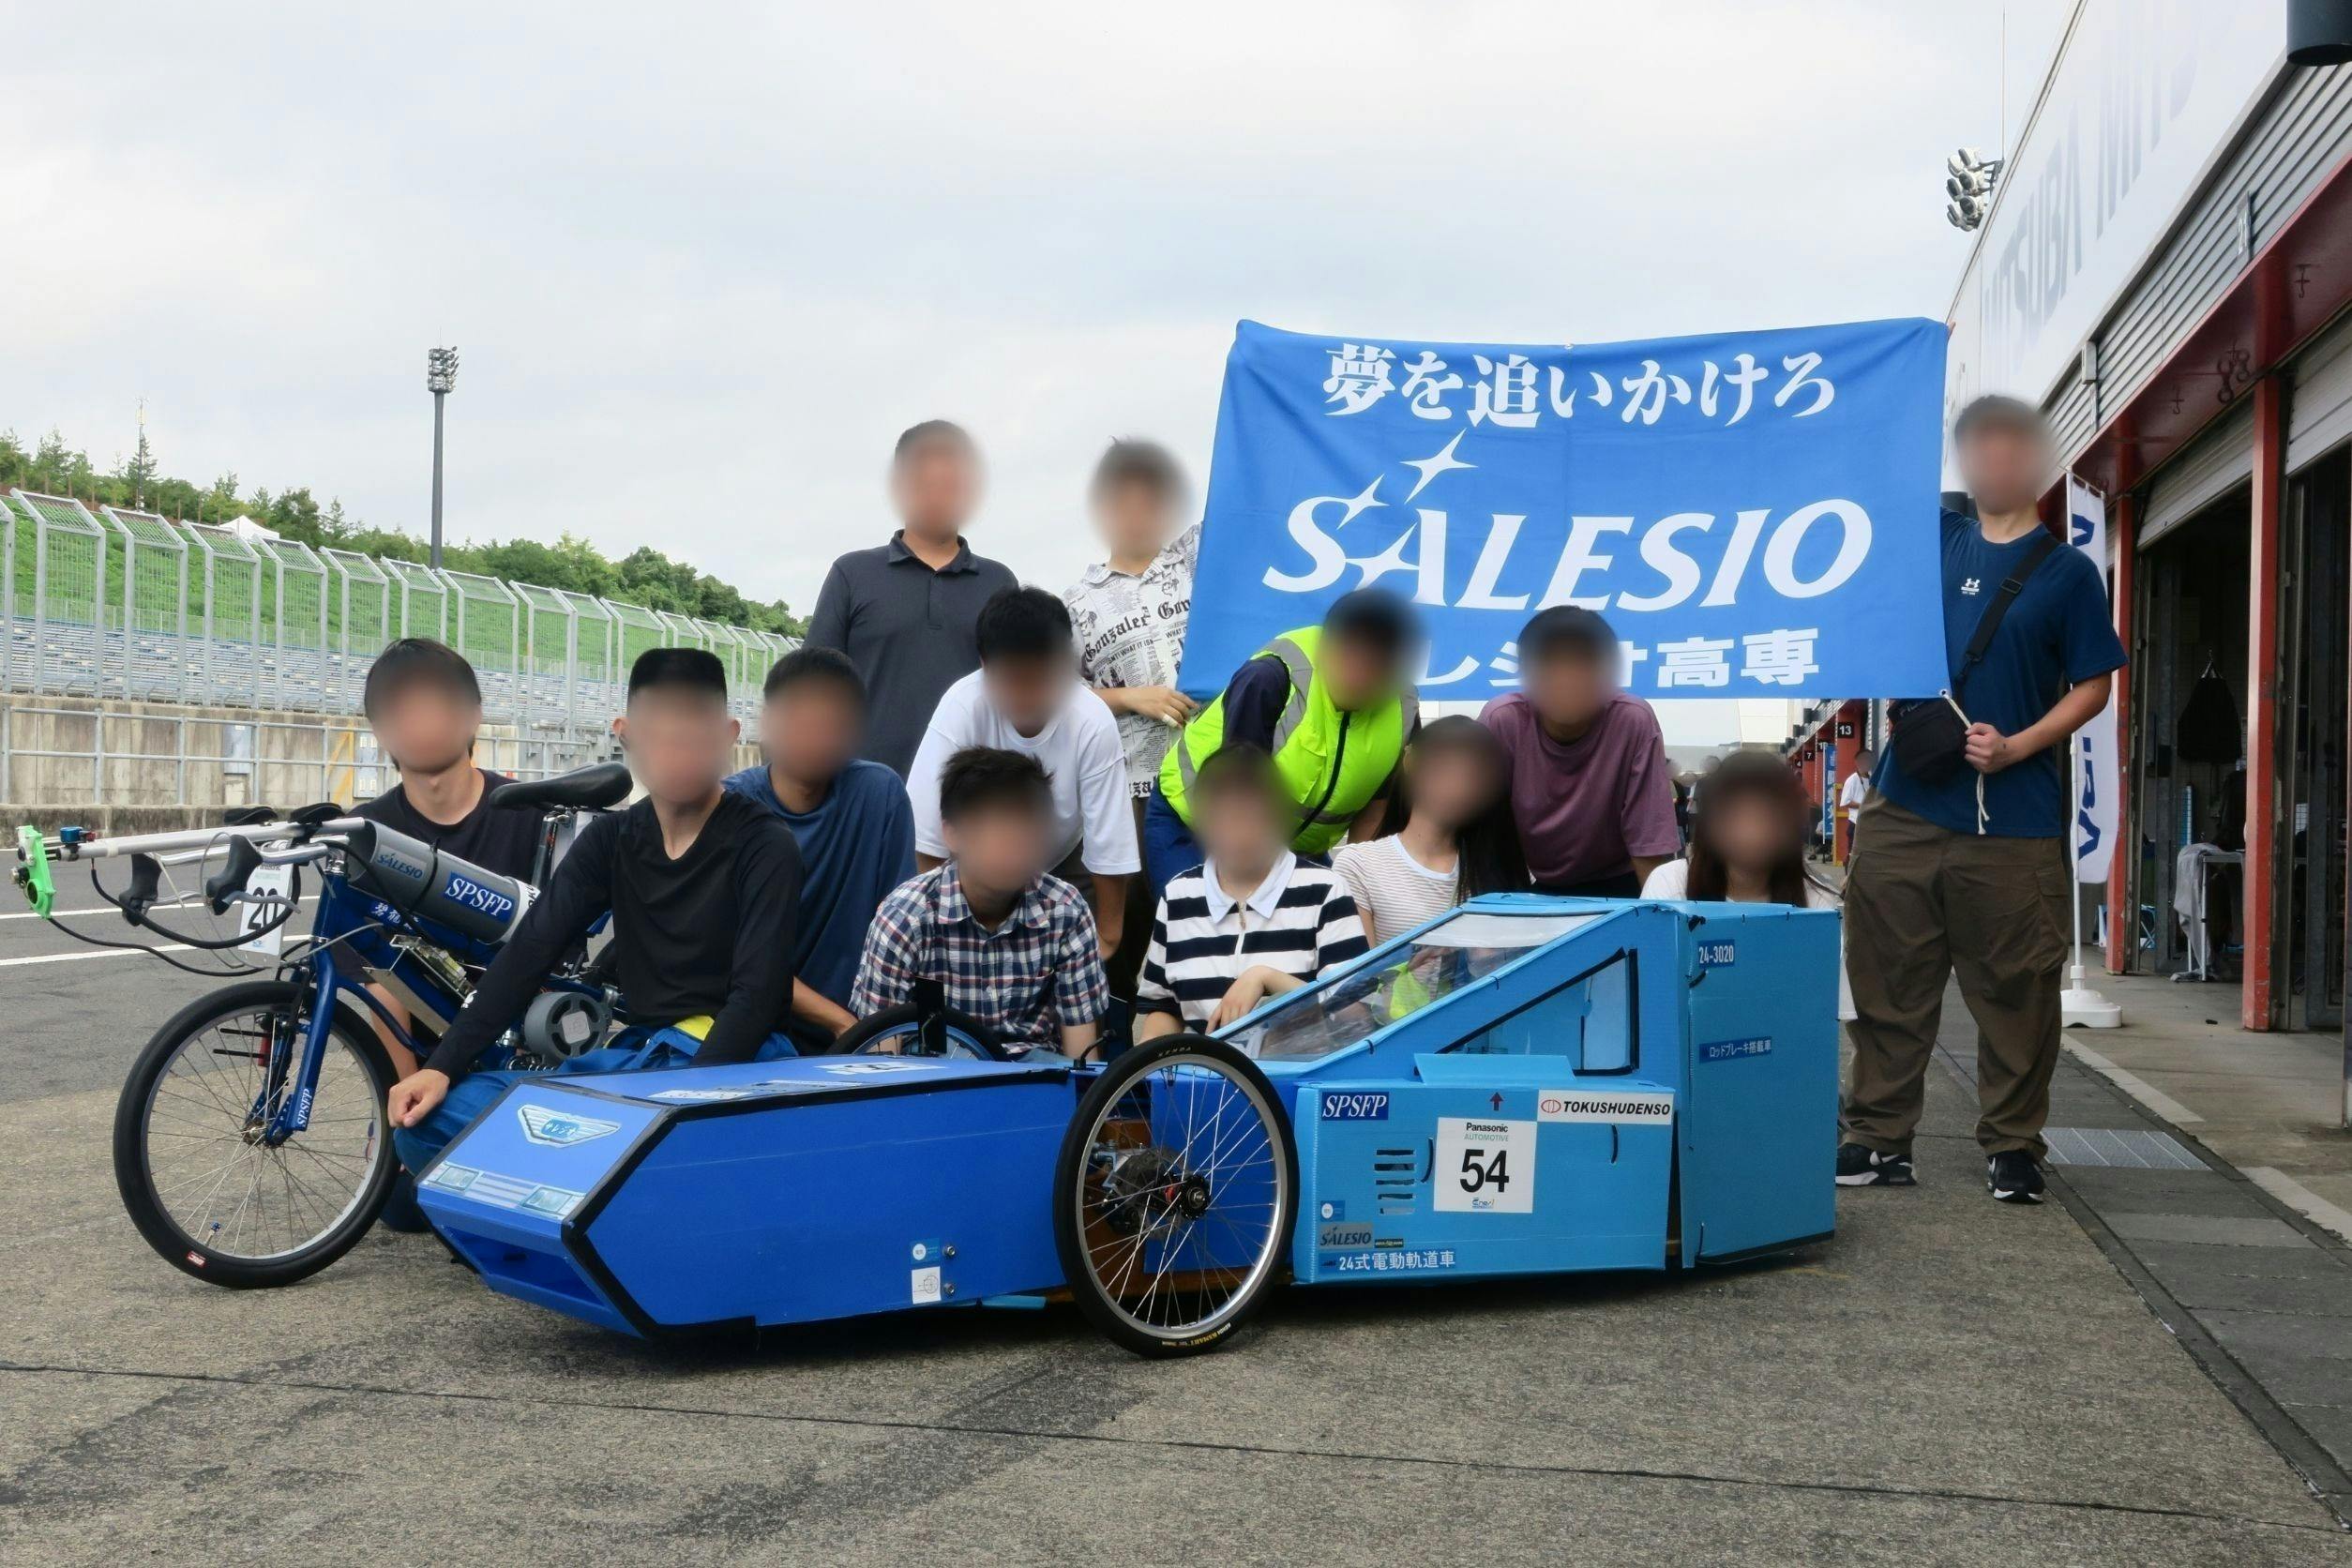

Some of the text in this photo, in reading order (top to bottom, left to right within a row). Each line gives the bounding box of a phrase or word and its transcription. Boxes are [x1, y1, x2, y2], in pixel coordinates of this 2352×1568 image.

[1321, 342, 1835, 429] 夢を追いかけろ
[1261, 474, 1874, 612] SALESIO
[1839, 725, 1852, 735] 13
[377, 852, 423, 880] SALESIO
[247, 886, 279, 931] 20
[445, 878, 512, 916] SPSFP
[1698, 944, 1734, 964] 24-3020
[297, 1088, 312, 1127] SPSFP
[1322, 1094, 1387, 1118] SPSFP
[1563, 1101, 1670, 1115] TOKUSHUDENSO
[1464, 1133, 1509, 1141] AUTOMOTIVE
[1466, 1123, 1508, 1133] Panasonic
[1460, 1149, 1510, 1193] 54
[1320, 1228, 1371, 1245] SALESIO
[1339, 1250, 1455, 1271] 24式電動軌道車
